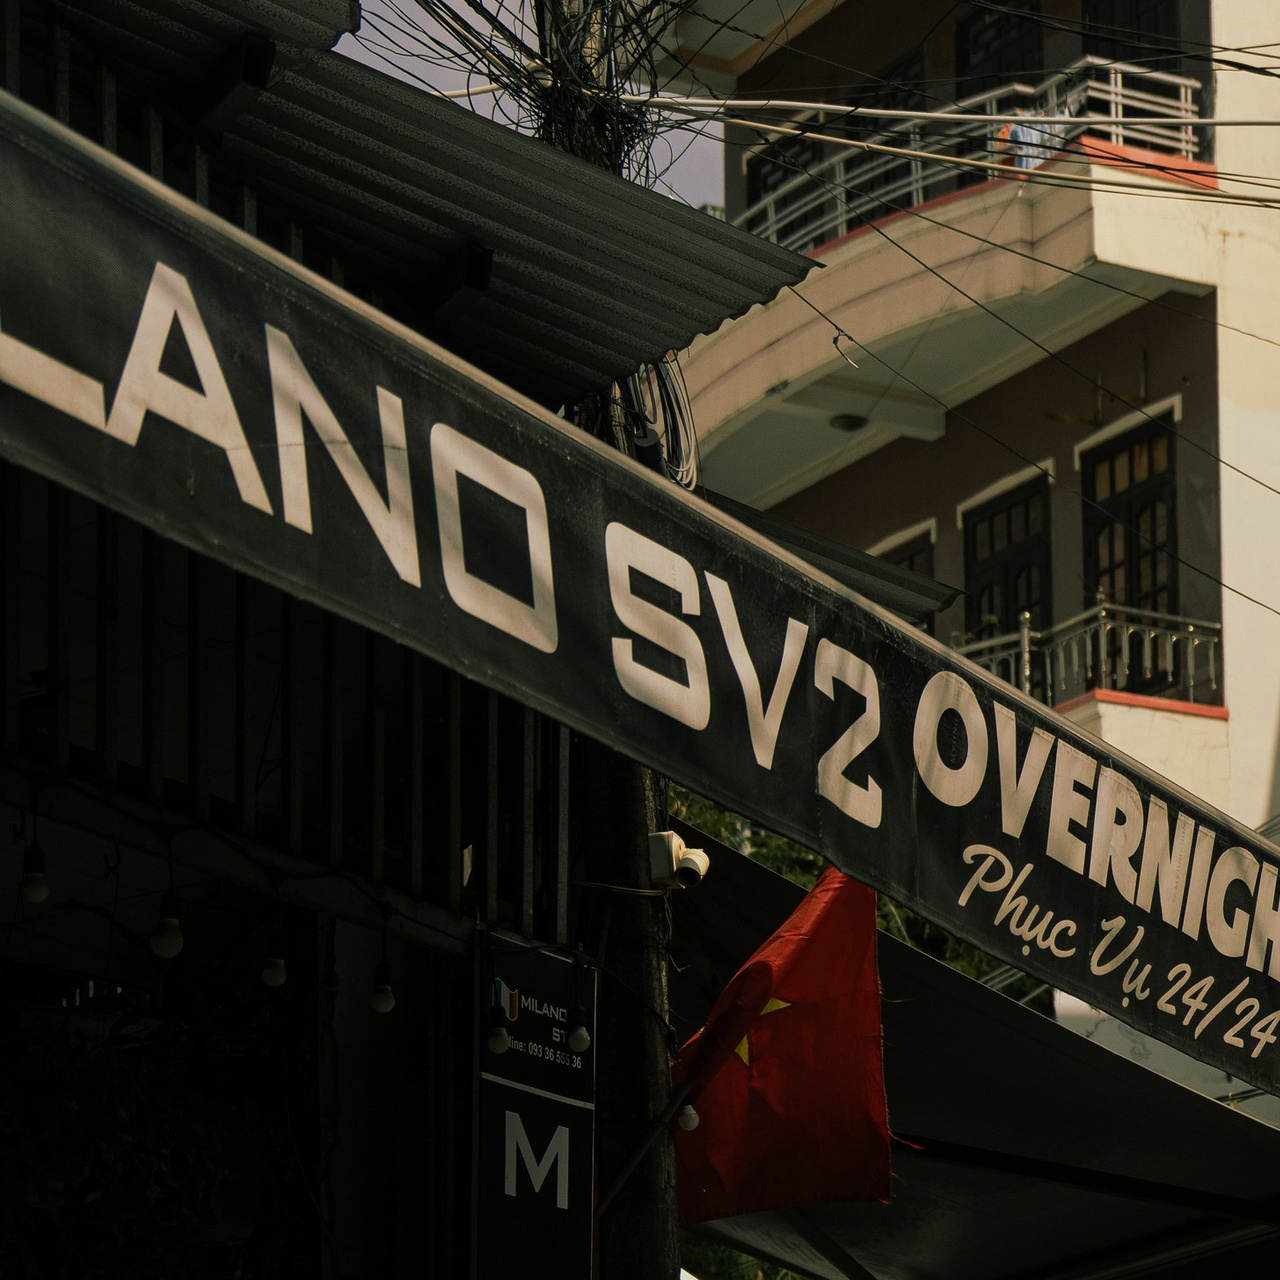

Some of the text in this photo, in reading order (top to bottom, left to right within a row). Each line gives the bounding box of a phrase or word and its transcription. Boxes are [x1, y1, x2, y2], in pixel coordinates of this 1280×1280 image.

[606, 521, 882, 829] SV2
[957, 844, 1078, 959] Phục
[1090, 915, 1150, 1007] Vụ
[521, 995, 568, 1022] MILANO
[528, 1042, 542, 1058] 093
[544, 1047, 554, 1061] 36
[556, 1051, 570, 1066] 555
[572, 1055, 582, 1069] 36
